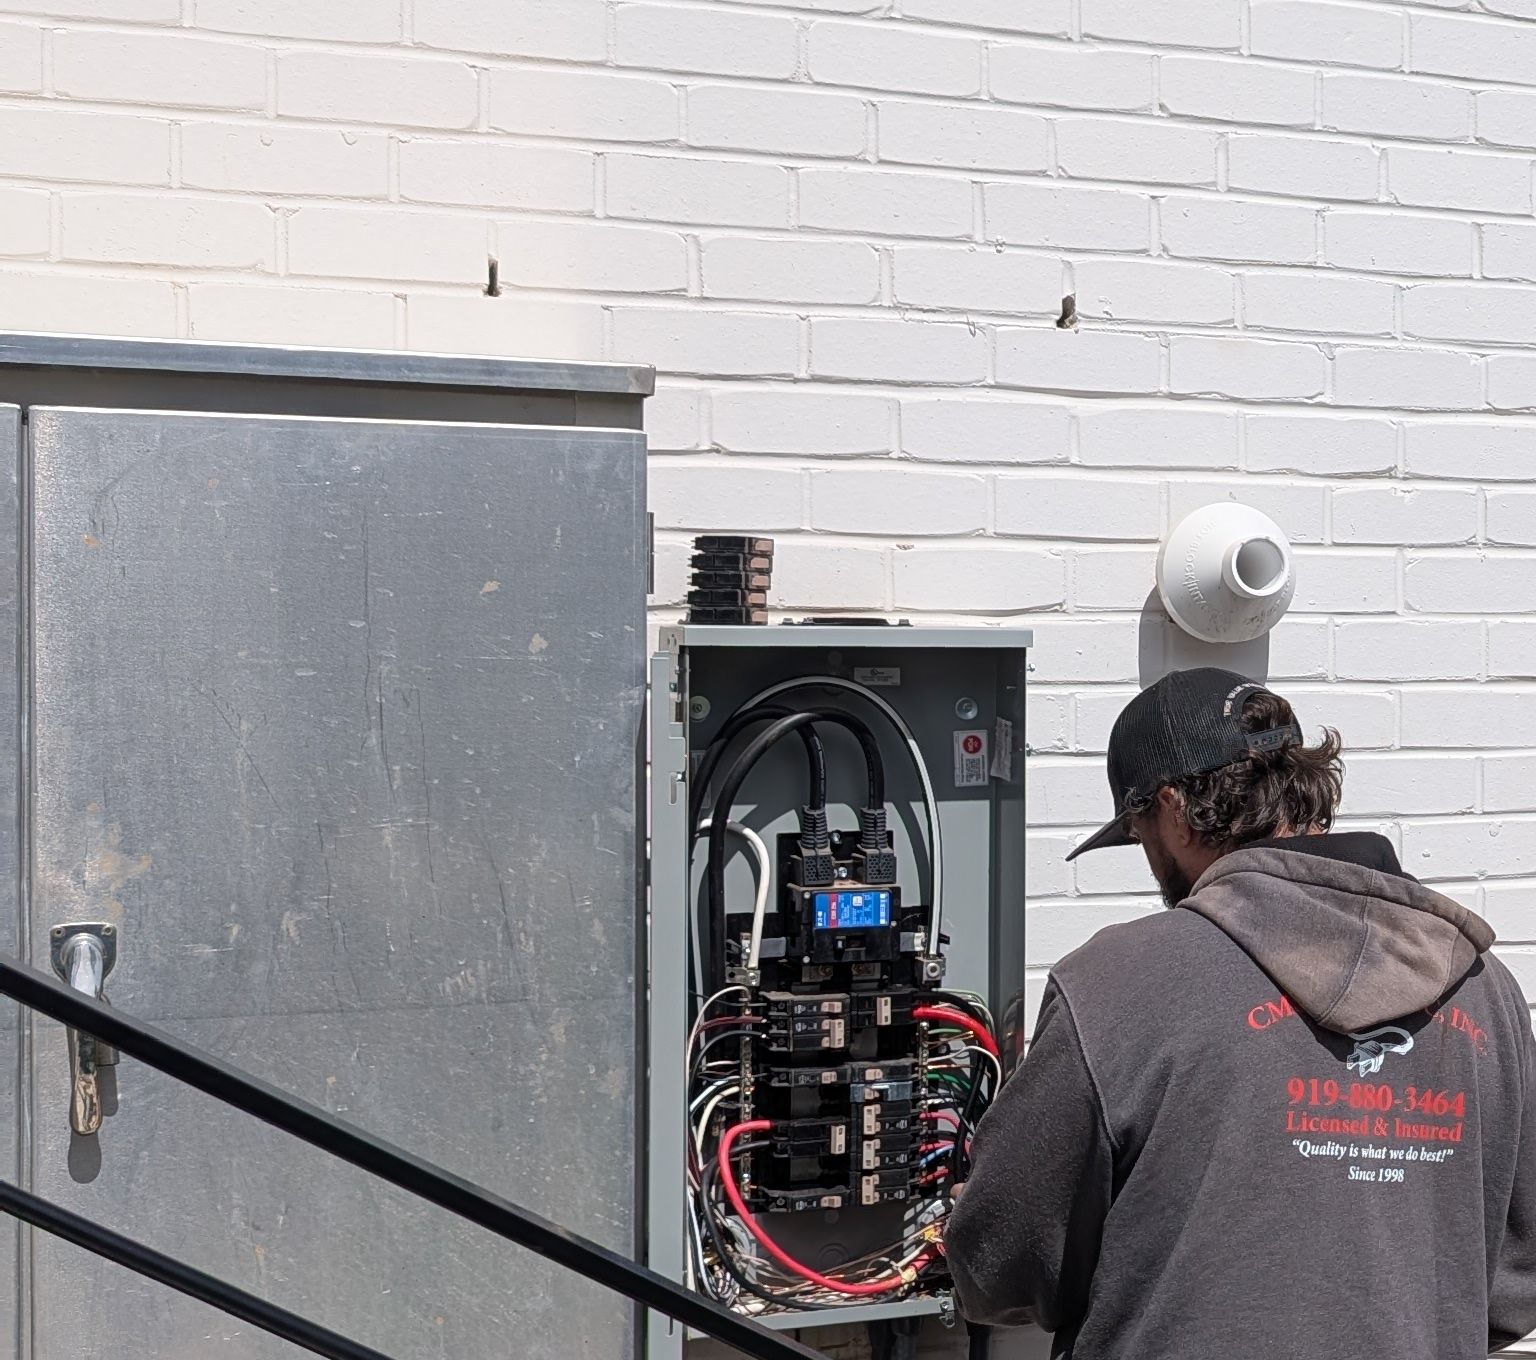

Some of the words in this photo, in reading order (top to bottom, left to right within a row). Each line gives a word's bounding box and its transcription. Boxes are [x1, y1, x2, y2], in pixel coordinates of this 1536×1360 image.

[1247, 995, 1296, 1031] CM
[1286, 1077, 1466, 1117] 919-880-3464
[1286, 1110, 1370, 1137] Licensed
[1374, 1116, 1390, 1137] &
[1395, 1118, 1463, 1142] Insured
[1349, 1143, 1359, 1158] is
[1361, 1143, 1388, 1160] what
[1389, 1148, 1405, 1161] we
[1405, 1146, 1419, 1161] do
[1348, 1165, 1376, 1182] Since
[1377, 1167, 1405, 1183] 1998
